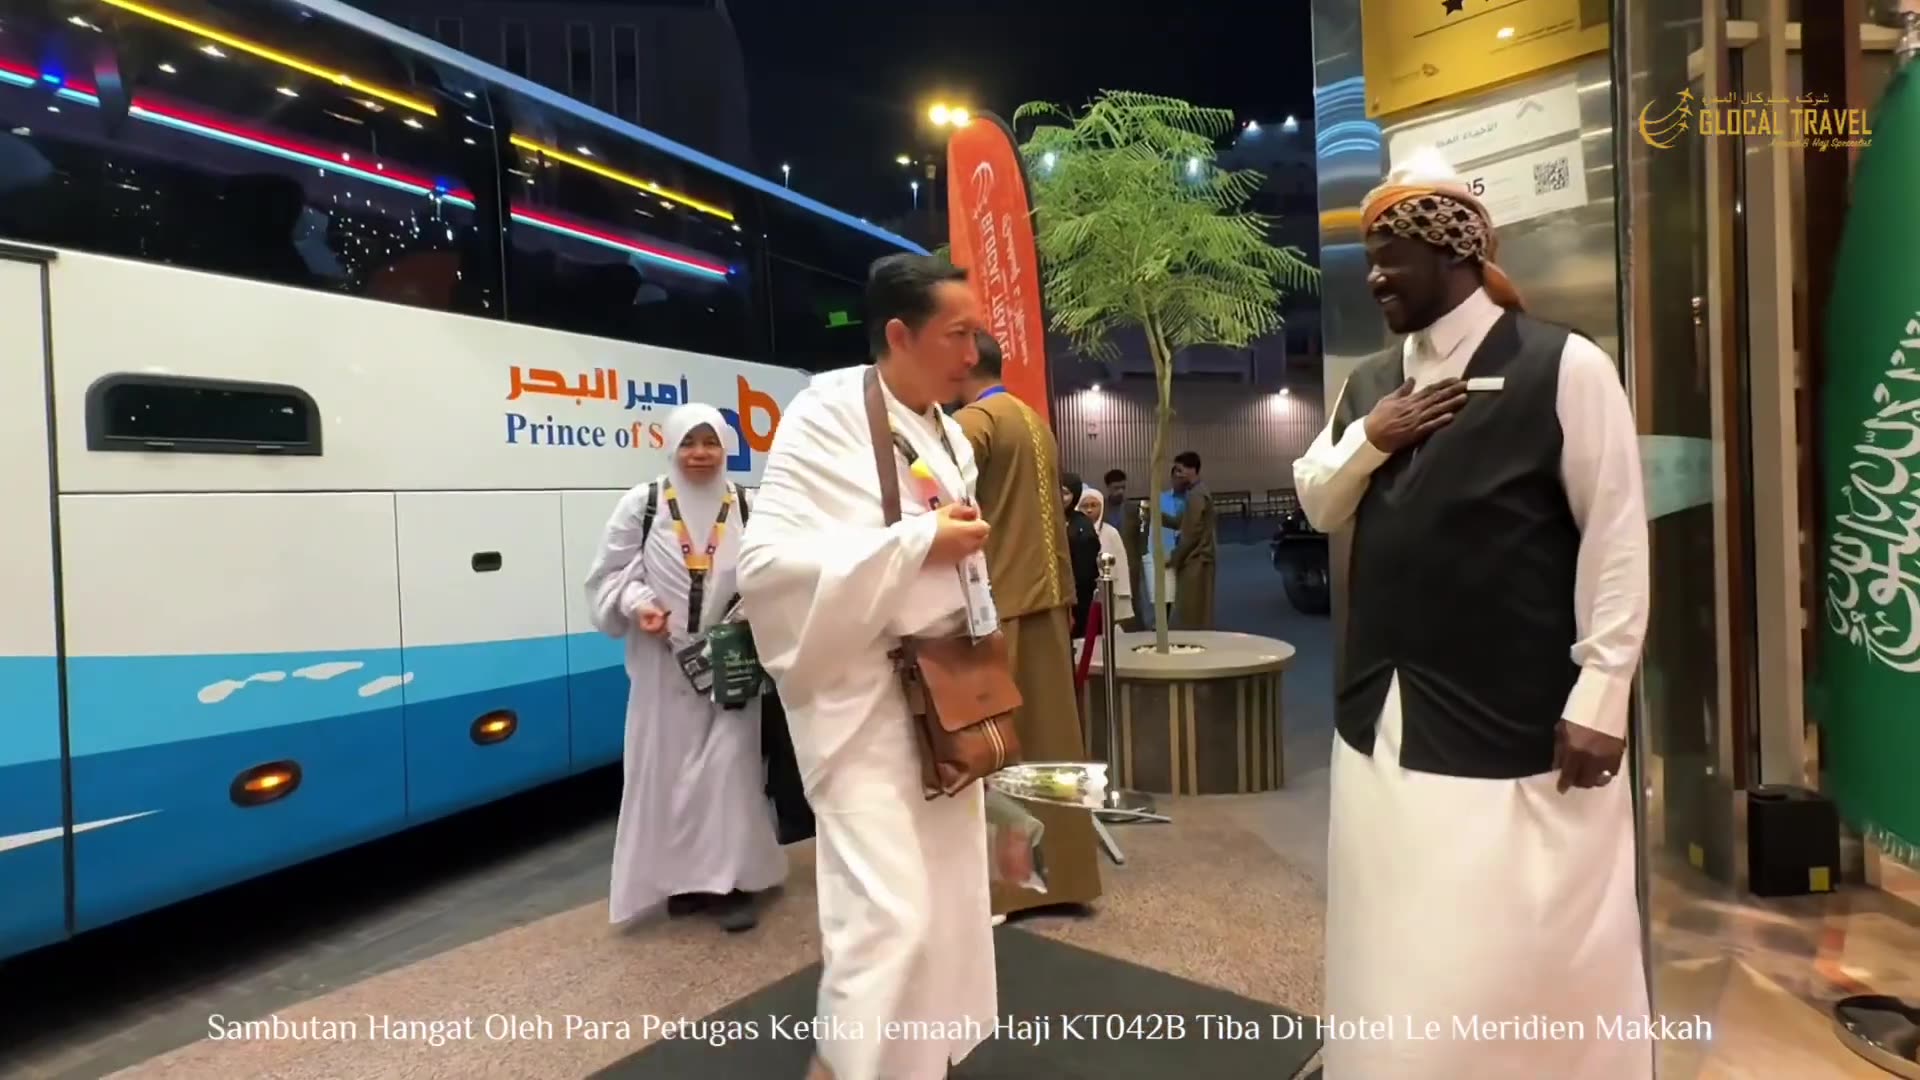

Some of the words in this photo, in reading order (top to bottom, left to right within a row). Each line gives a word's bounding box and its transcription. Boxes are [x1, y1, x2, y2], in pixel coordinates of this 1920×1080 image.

[506, 365, 619, 405] البحر
[624, 374, 689, 410] أمير
[505, 412, 606, 448] Prince
[615, 421, 642, 449] of
